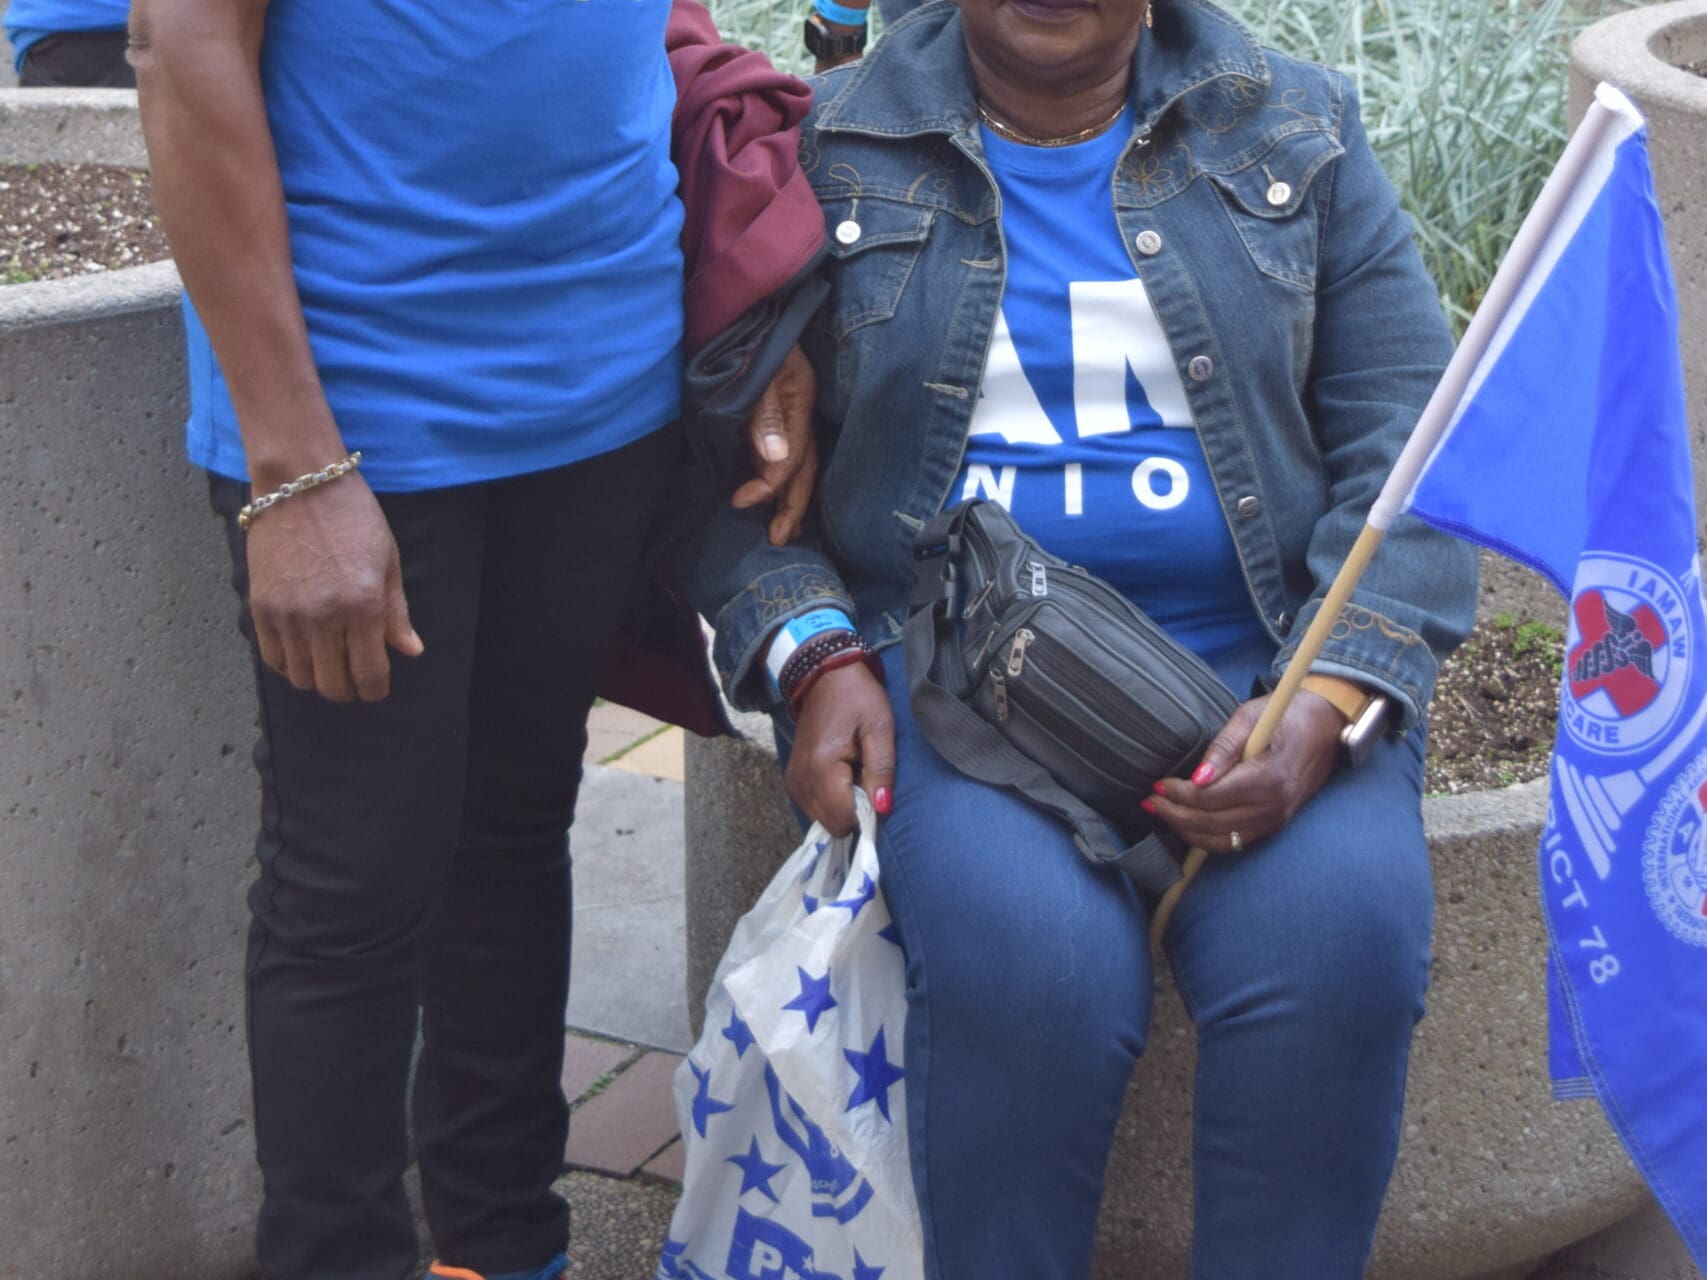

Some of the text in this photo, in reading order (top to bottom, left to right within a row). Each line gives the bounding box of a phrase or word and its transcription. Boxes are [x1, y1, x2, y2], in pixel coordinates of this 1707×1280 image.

[968, 278, 1196, 445] AM
[961, 456, 1190, 515] NIO
[1626, 570, 1688, 659] IAMAW
[1562, 686, 1621, 745] CARE
[1656, 793, 1688, 891] INTERNATIONAL
[1578, 925, 1621, 985] 78
